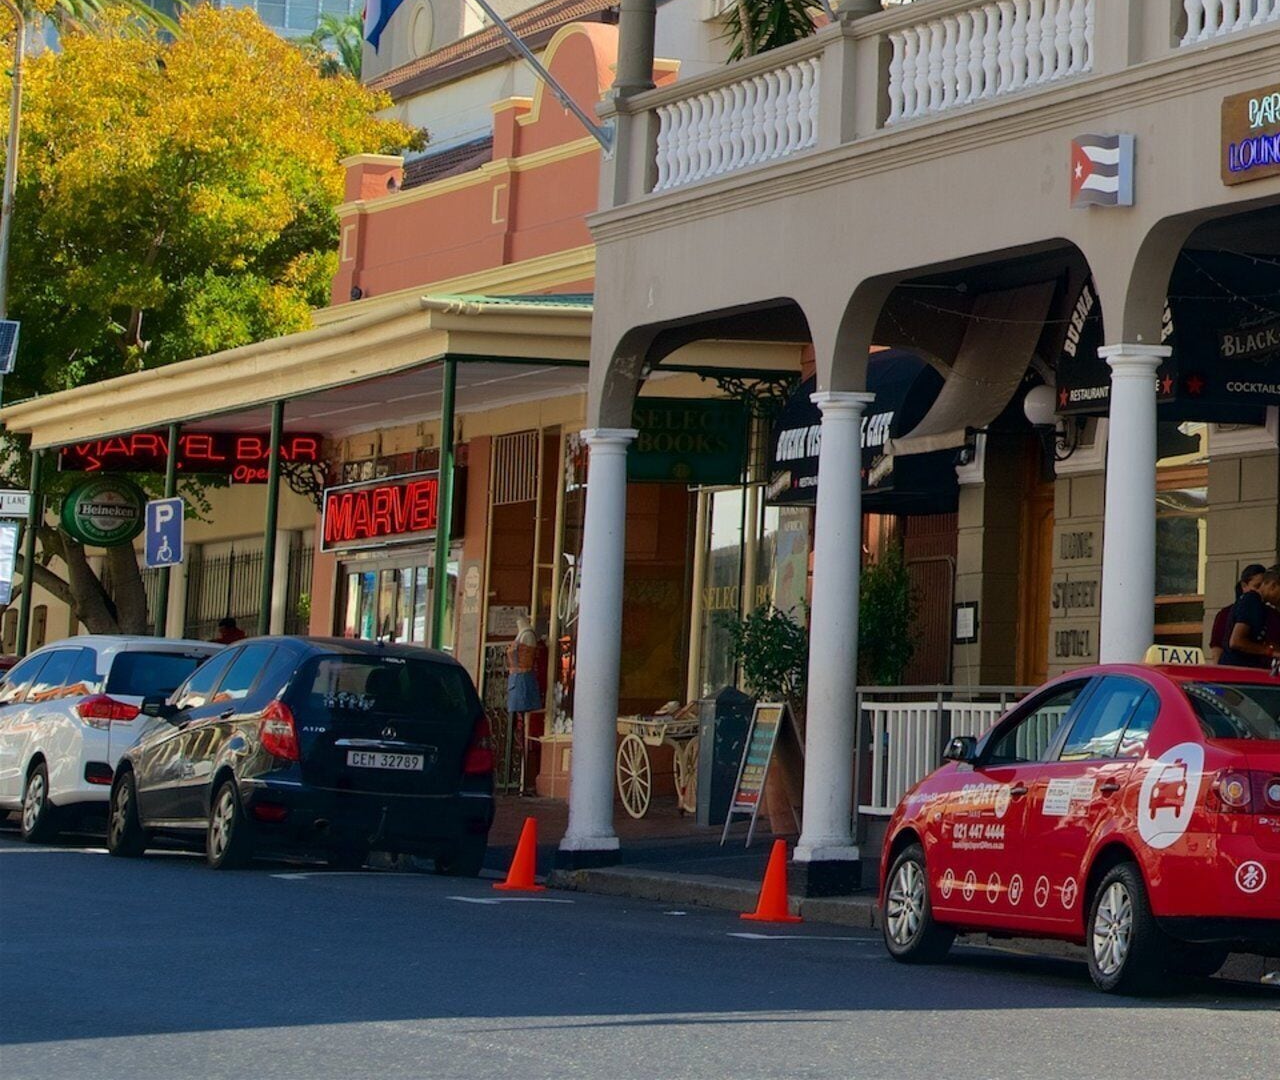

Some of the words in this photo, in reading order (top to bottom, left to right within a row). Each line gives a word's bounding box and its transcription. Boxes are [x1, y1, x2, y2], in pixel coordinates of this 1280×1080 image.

[1064, 285, 1095, 358] BUENA
[1220, 327, 1279, 357] BLACK
[1069, 385, 1110, 402] RESTAURANT
[233, 464, 270, 483] Ope
[6, 496, 27, 506] LANE
[81, 504, 134, 518] Heineken
[154, 503, 175, 533] P
[325, 479, 439, 542] MARVEL
[1052, 580, 1099, 610] STREET
[1158, 647, 1200, 665] TAXI
[352, 752, 376, 766] CEM
[380, 754, 420, 769] 32789
[953, 824, 969, 840] 021
[969, 824, 984, 840] 447
[984, 824, 1006, 841] 4444
